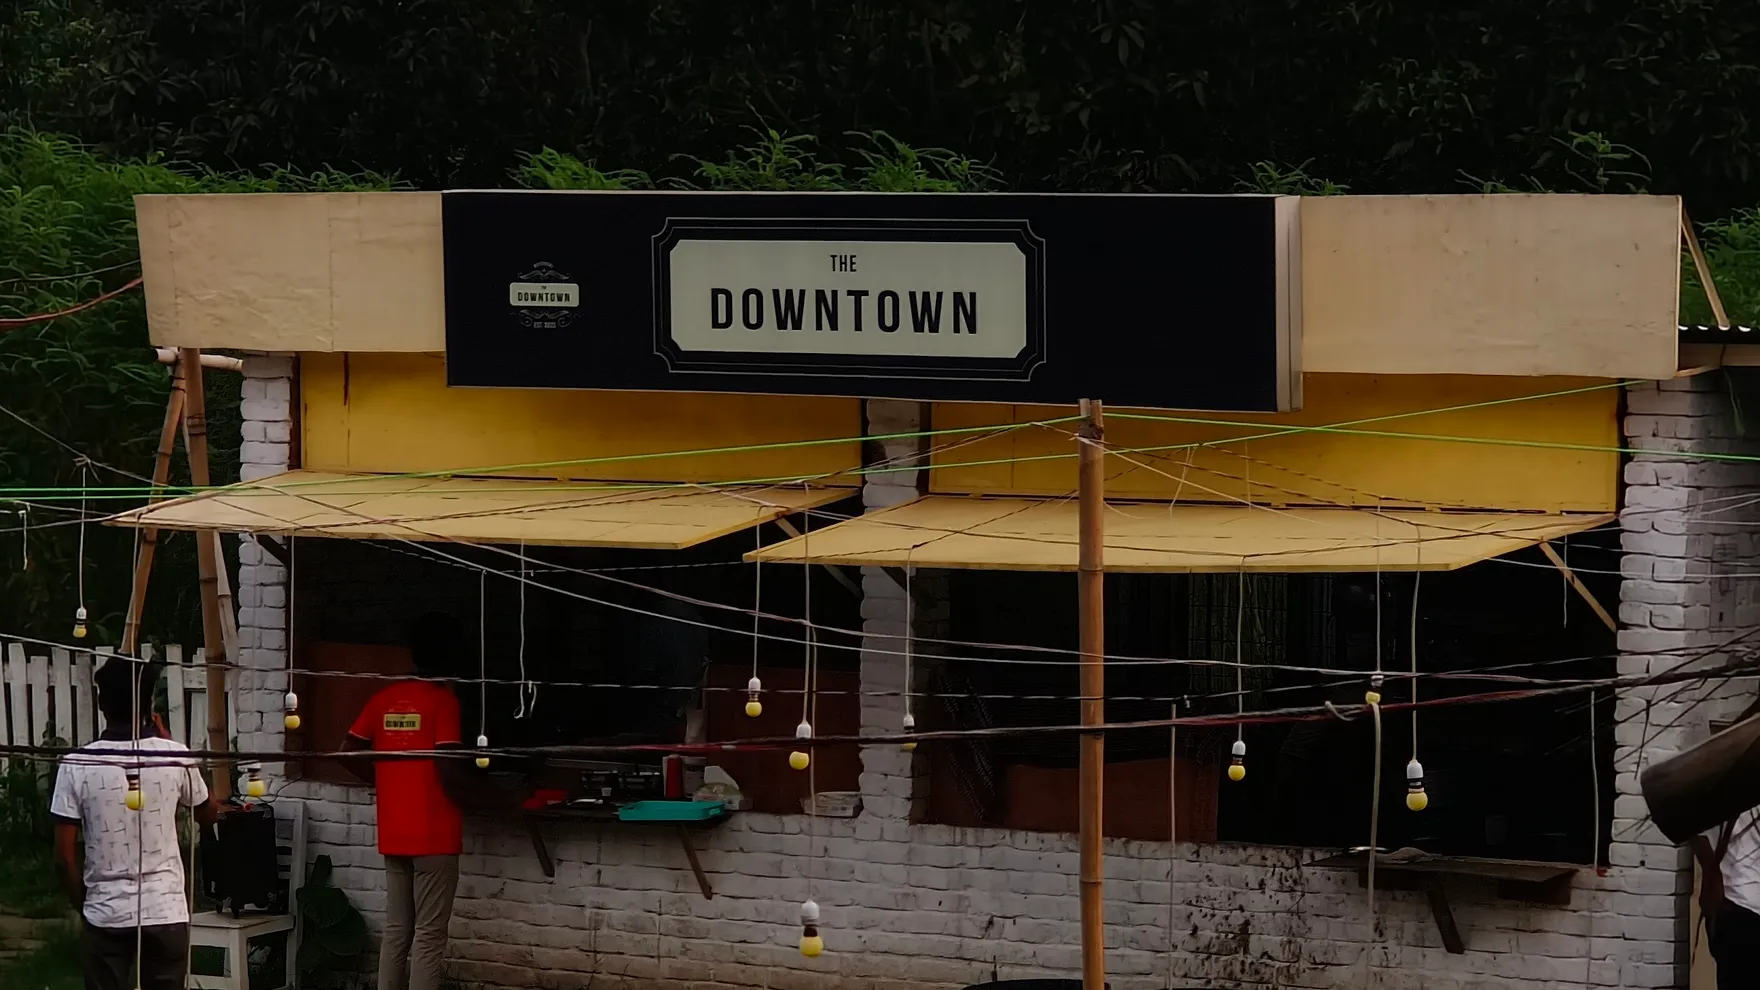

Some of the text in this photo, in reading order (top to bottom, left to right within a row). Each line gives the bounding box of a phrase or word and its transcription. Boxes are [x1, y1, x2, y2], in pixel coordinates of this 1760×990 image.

[830, 254, 857, 272] THE
[517, 292, 571, 302] DOWNTOWN
[711, 287, 977, 335] DOWNTOWN
